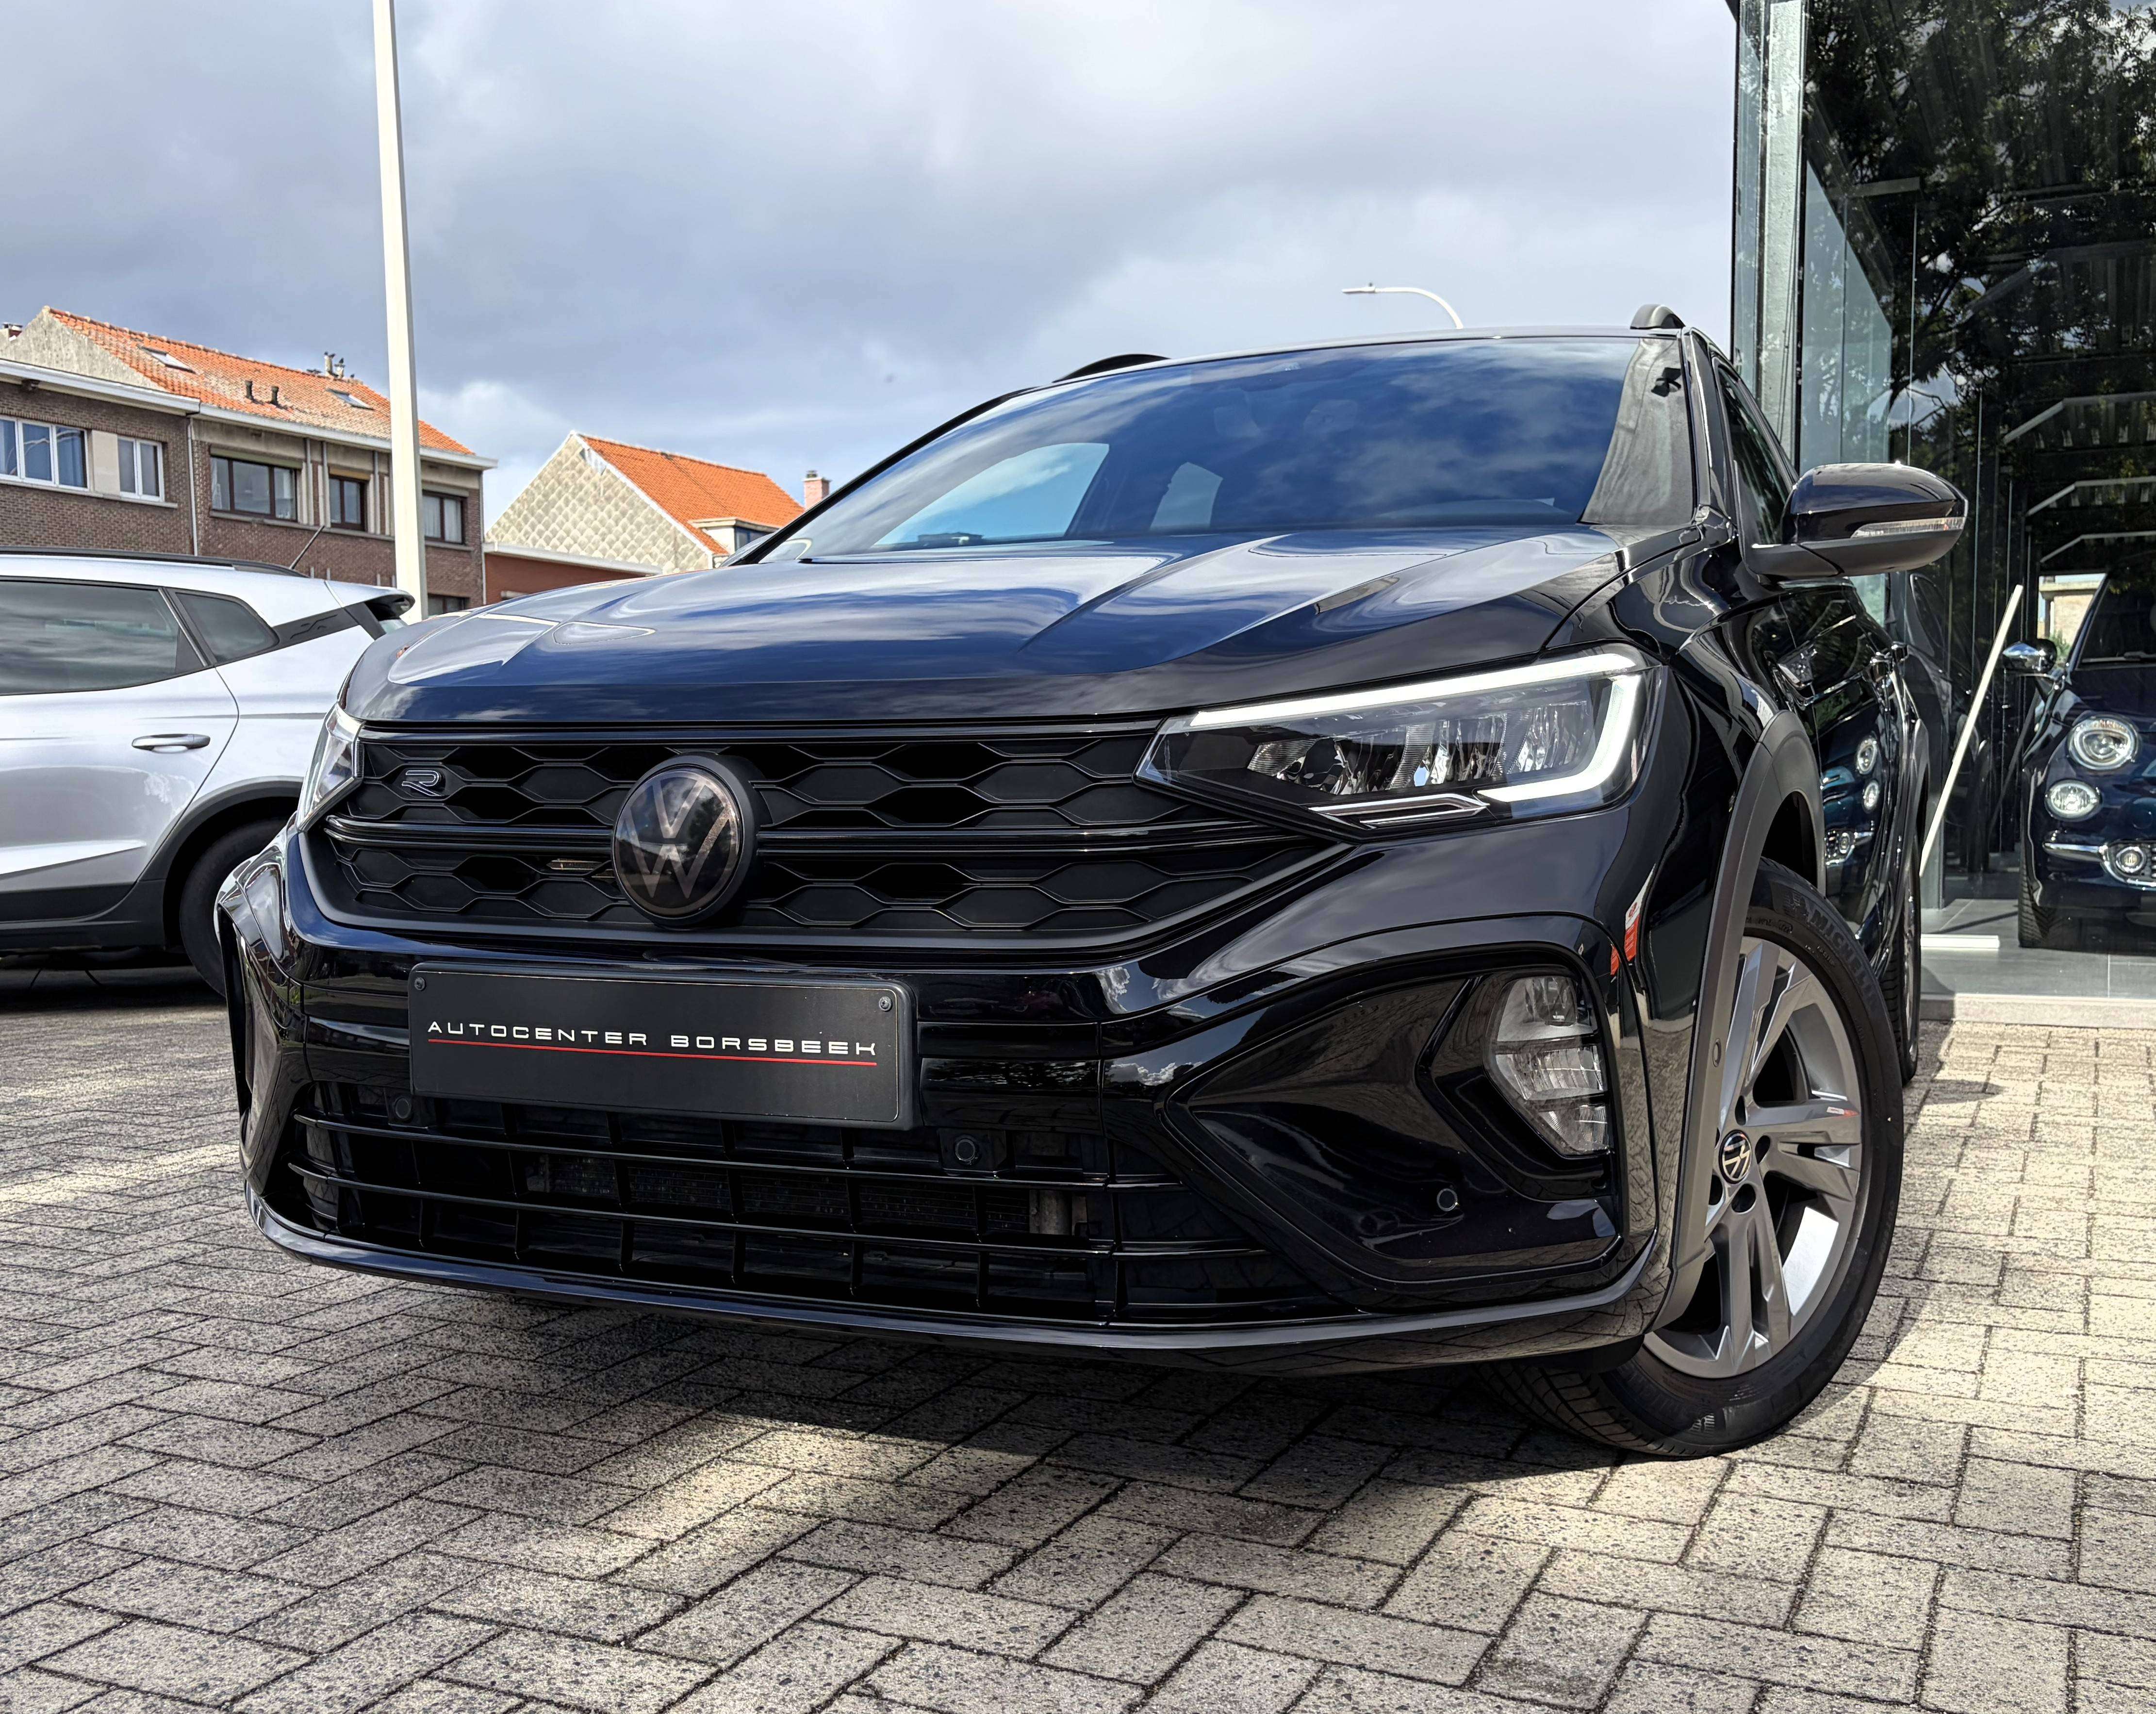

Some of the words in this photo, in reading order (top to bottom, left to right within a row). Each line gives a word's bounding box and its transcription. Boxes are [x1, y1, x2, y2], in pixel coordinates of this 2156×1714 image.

[401, 770, 441, 796] R
[428, 1021, 647, 1045] AUTOCENTER
[671, 1035, 876, 1055] BORSBEEK
